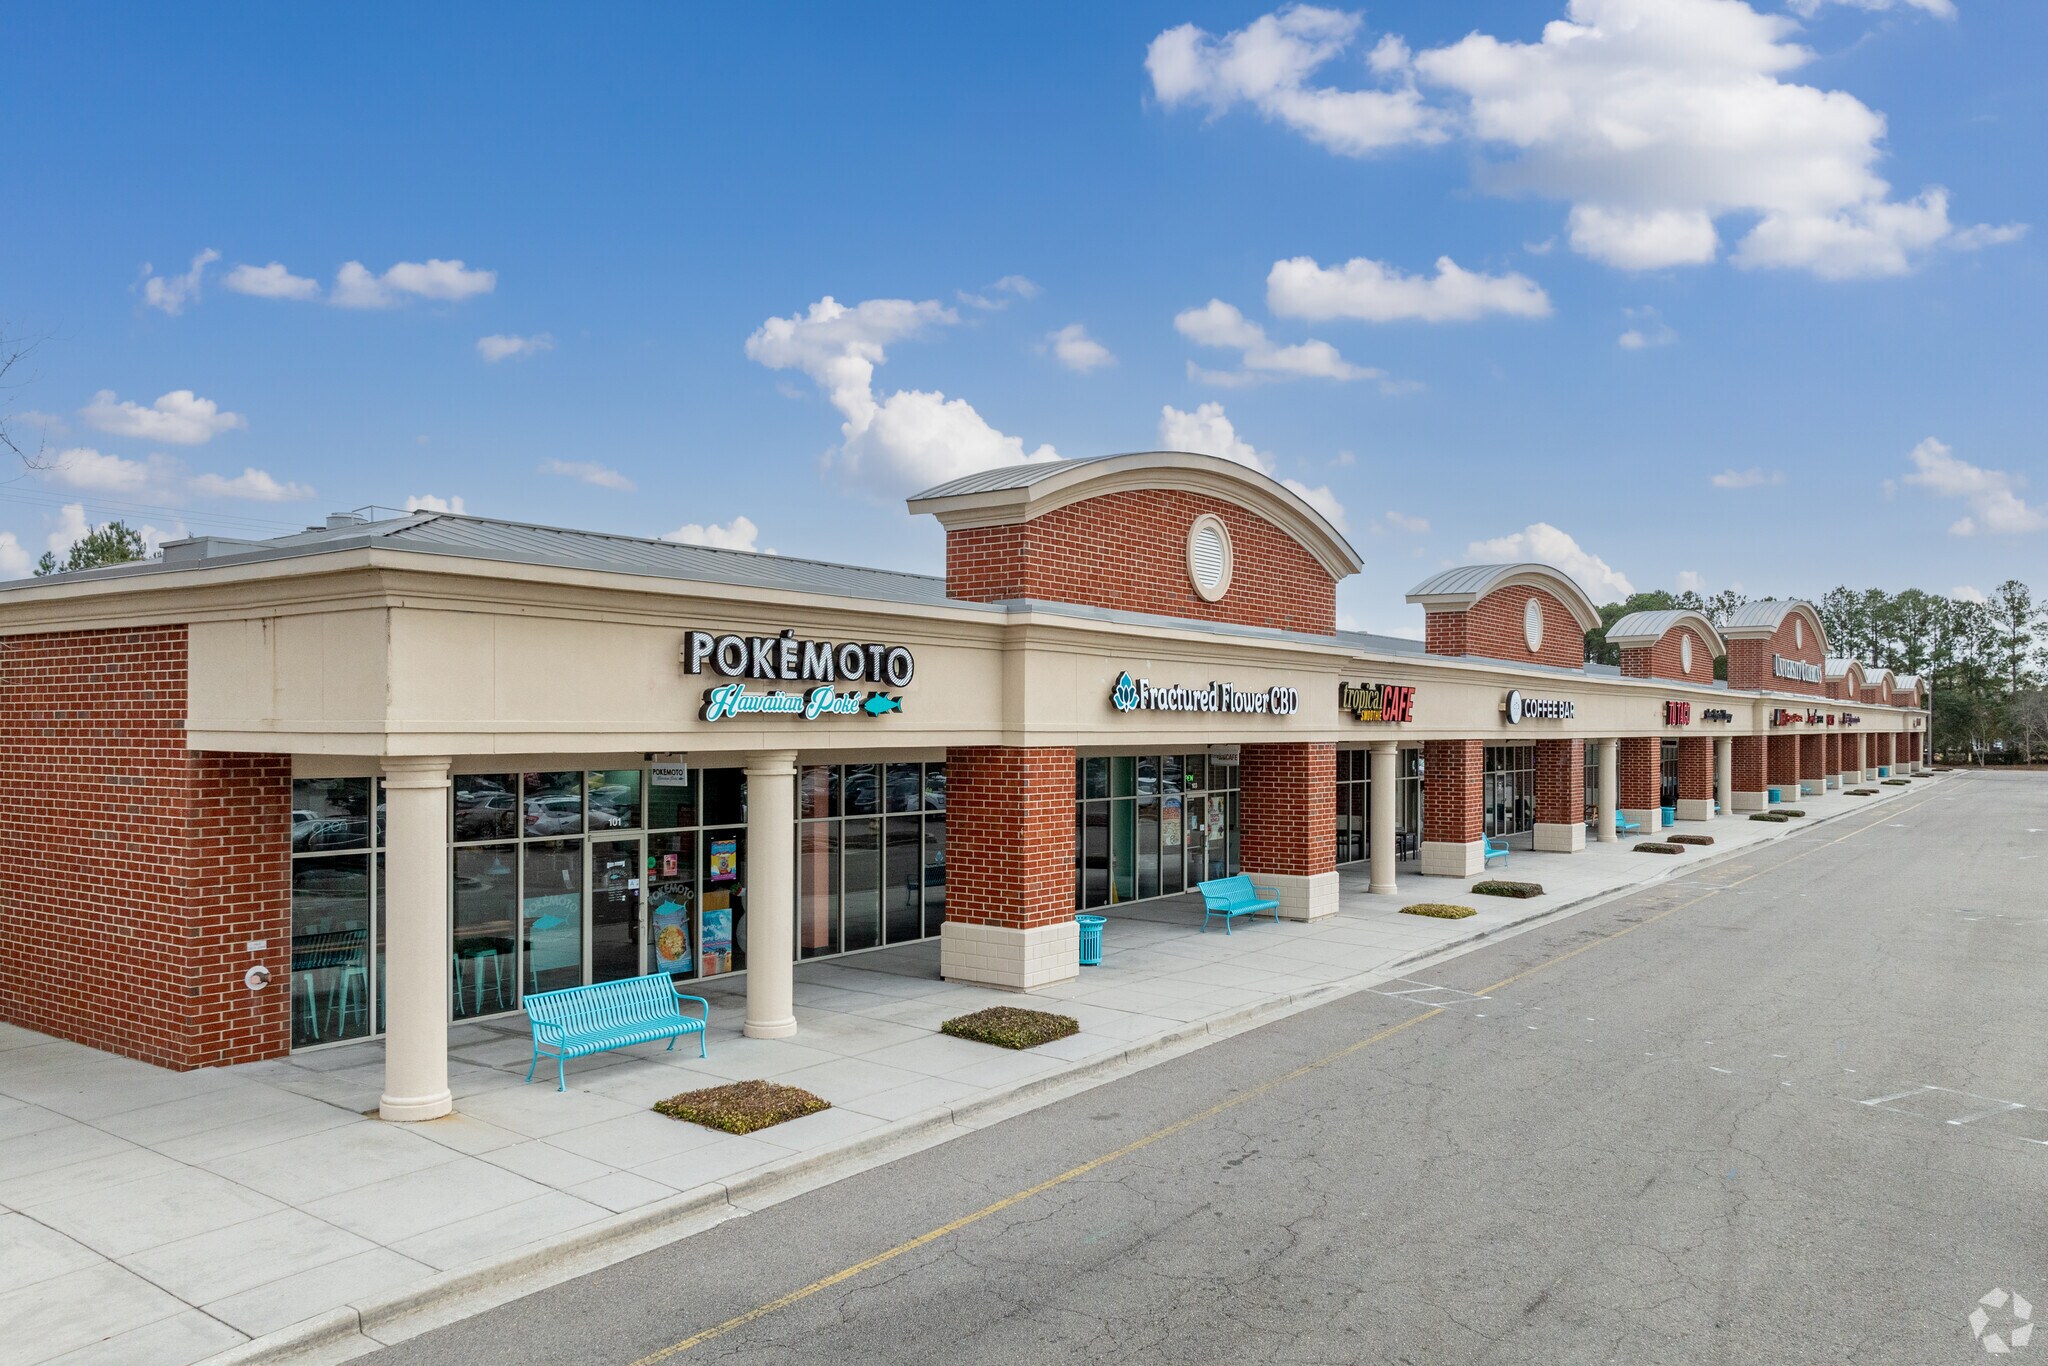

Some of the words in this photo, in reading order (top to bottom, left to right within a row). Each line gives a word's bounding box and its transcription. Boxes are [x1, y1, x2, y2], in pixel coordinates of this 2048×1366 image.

[685, 629, 914, 687] POKÉMOTO
[704, 684, 804, 721] Hawaiian
[805, 685, 860, 721] Poké
[1138, 678, 1219, 712] Fractured
[1221, 682, 1269, 714] Flower
[1270, 686, 1299, 715] CBD
[1341, 683, 1384, 714] tropical
[1382, 685, 1415, 722] CAFE
[1524, 699, 1558, 718] COFFEE
[1559, 701, 1575, 719] BAR
[312, 821, 347, 837] open
[608, 817, 622, 827] 101
